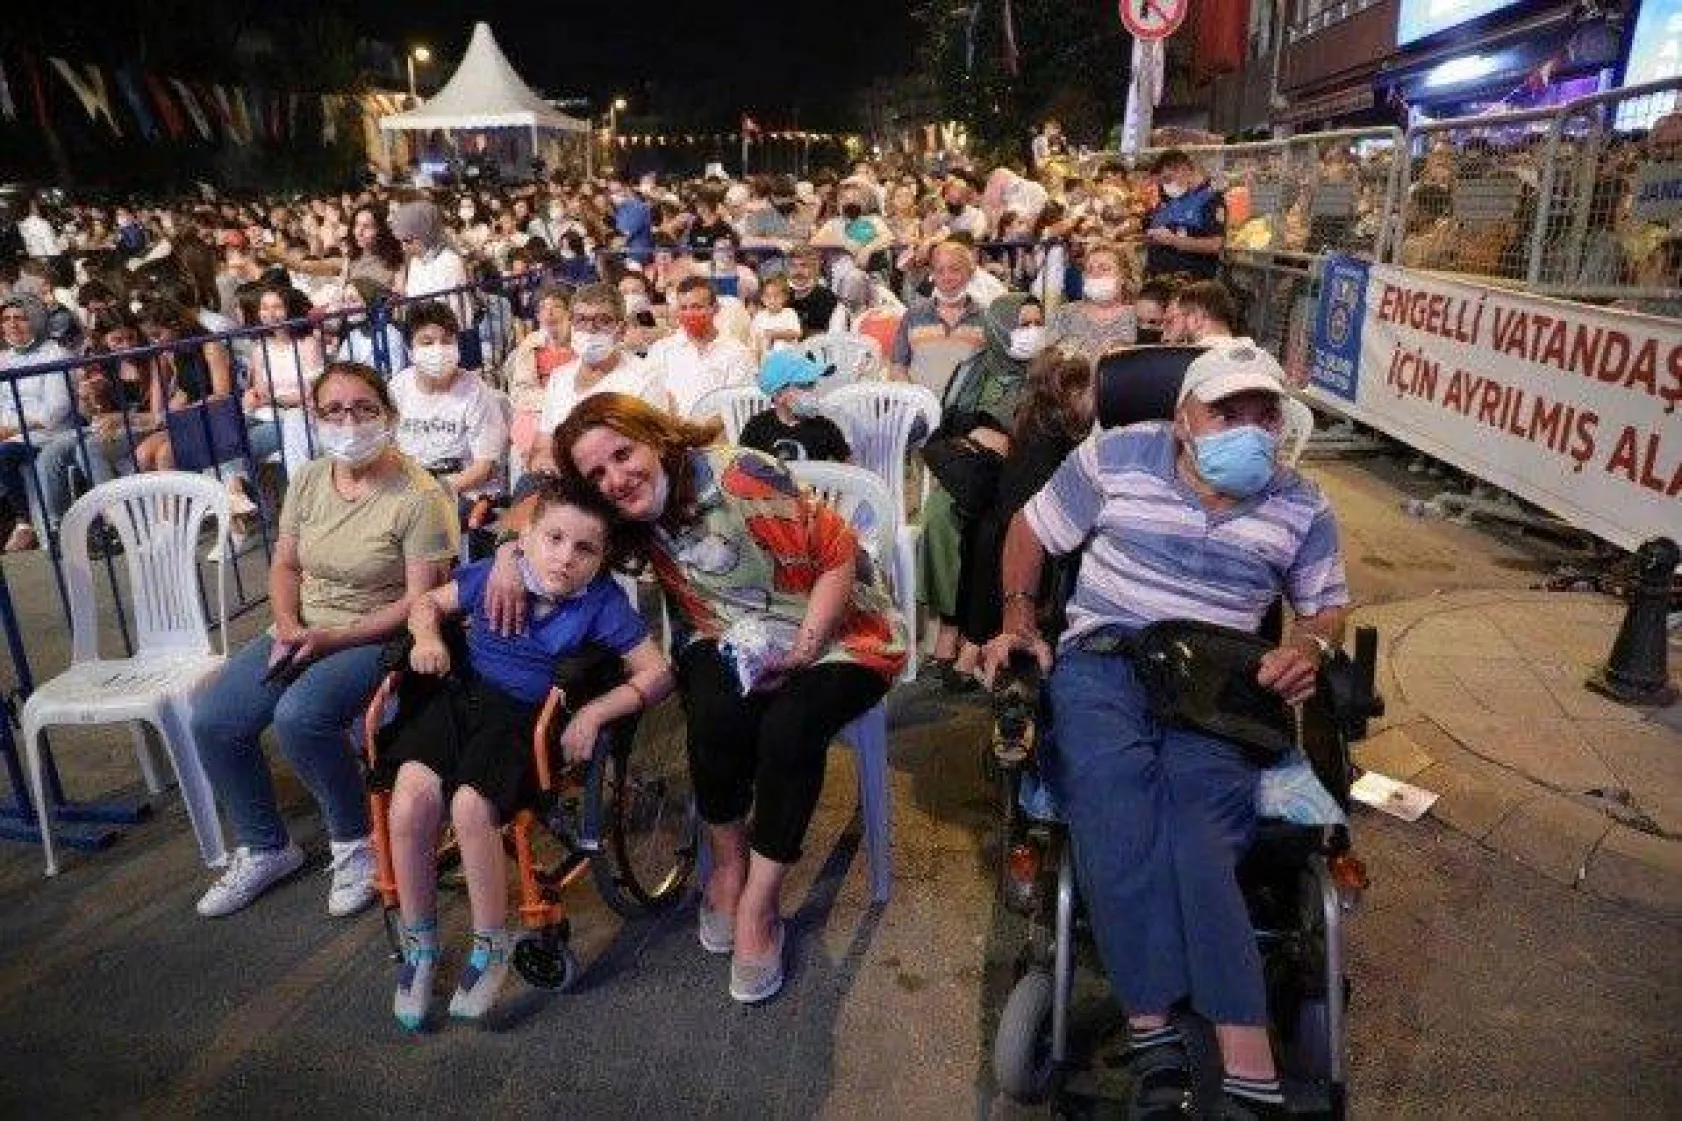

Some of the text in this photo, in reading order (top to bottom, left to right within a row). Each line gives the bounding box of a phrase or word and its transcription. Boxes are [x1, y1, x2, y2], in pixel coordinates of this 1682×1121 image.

[1378, 283, 1487, 345] ENGELLİ
[1387, 341, 1440, 402] İÇİN
[1442, 370, 1598, 472] AYRILMIŞ
